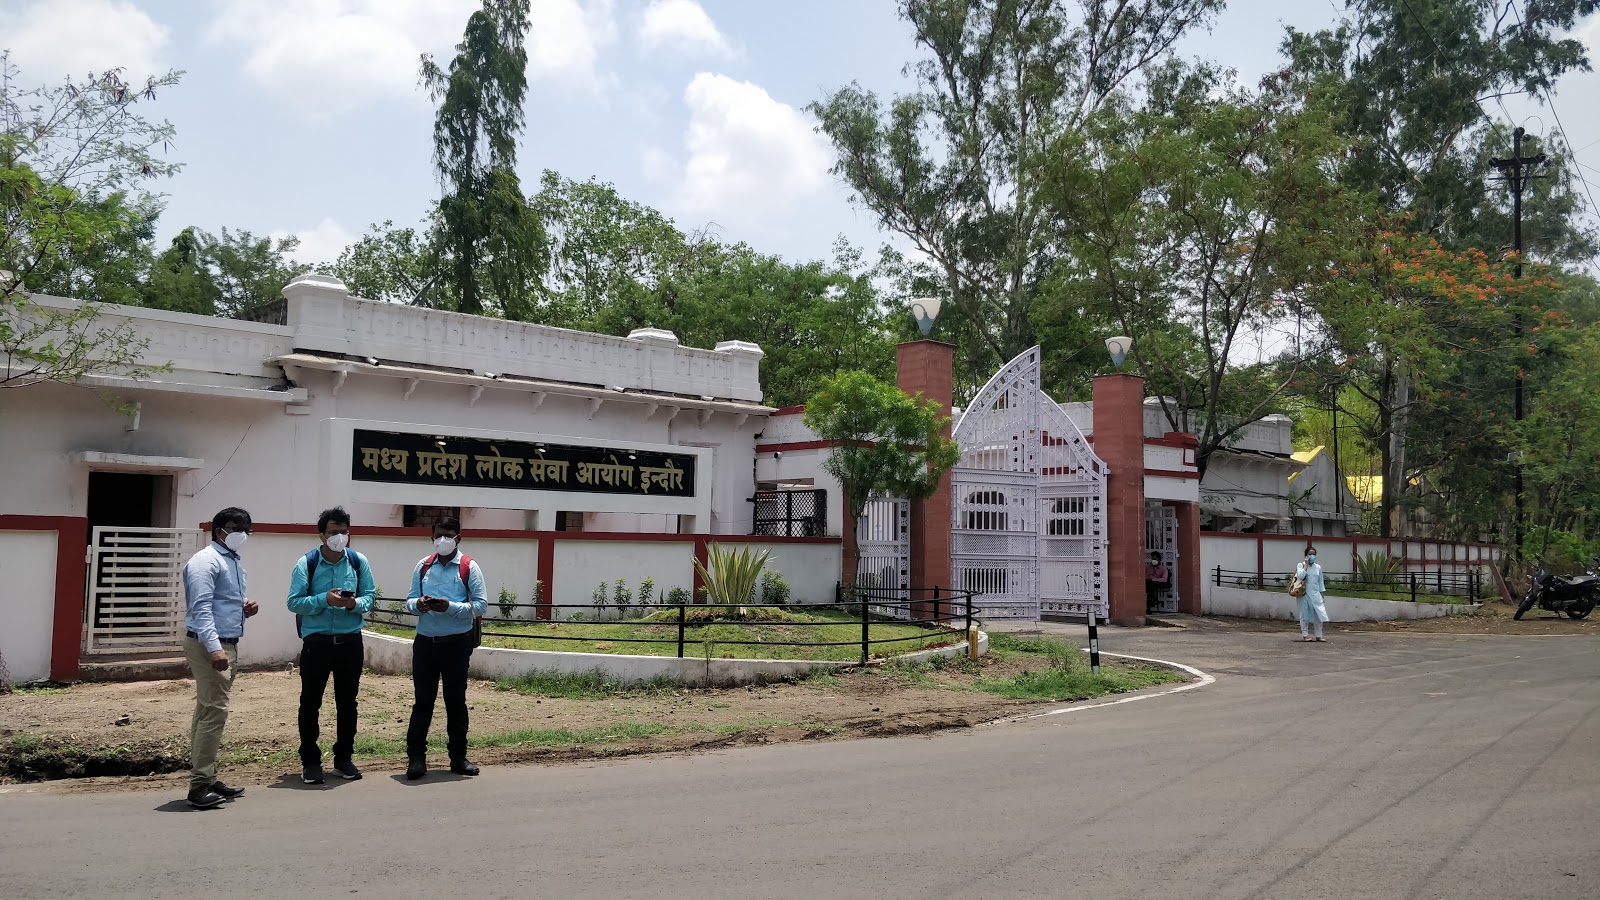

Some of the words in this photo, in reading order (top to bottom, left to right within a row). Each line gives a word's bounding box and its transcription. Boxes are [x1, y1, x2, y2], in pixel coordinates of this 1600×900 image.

[360, 447, 409, 475] मध्य
[415, 441, 468, 480] प्रदेश
[473, 445, 524, 481] लोक
[528, 449, 570, 484] सेवा
[575, 454, 634, 487] आयोग
[639, 458, 684, 494] इन्दौर
